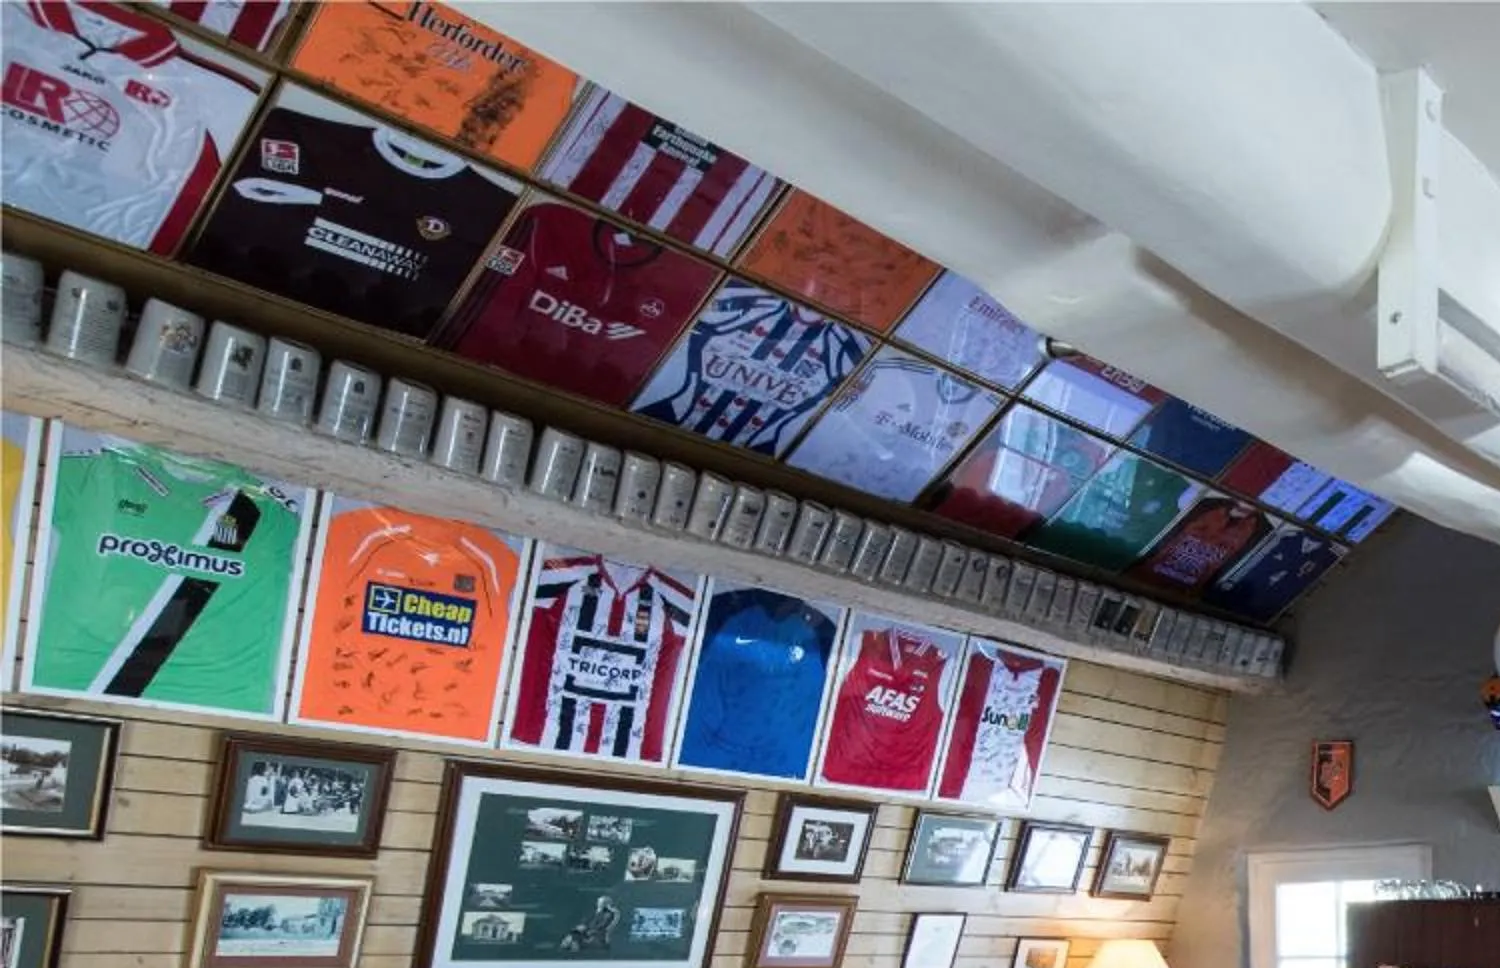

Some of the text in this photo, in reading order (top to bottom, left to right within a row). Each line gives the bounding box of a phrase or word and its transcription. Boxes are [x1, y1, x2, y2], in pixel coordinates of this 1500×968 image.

[408, 1, 526, 72] Herforder
[307, 227, 424, 272] CLEANAWAY
[528, 290, 602, 335] DiBa
[99, 534, 243, 576] proximus
[367, 611, 470, 645] Tickets.nl
[403, 593, 473, 625] Cheap
[568, 657, 642, 681] TRICORP
[865, 685, 921, 713] AFAS
